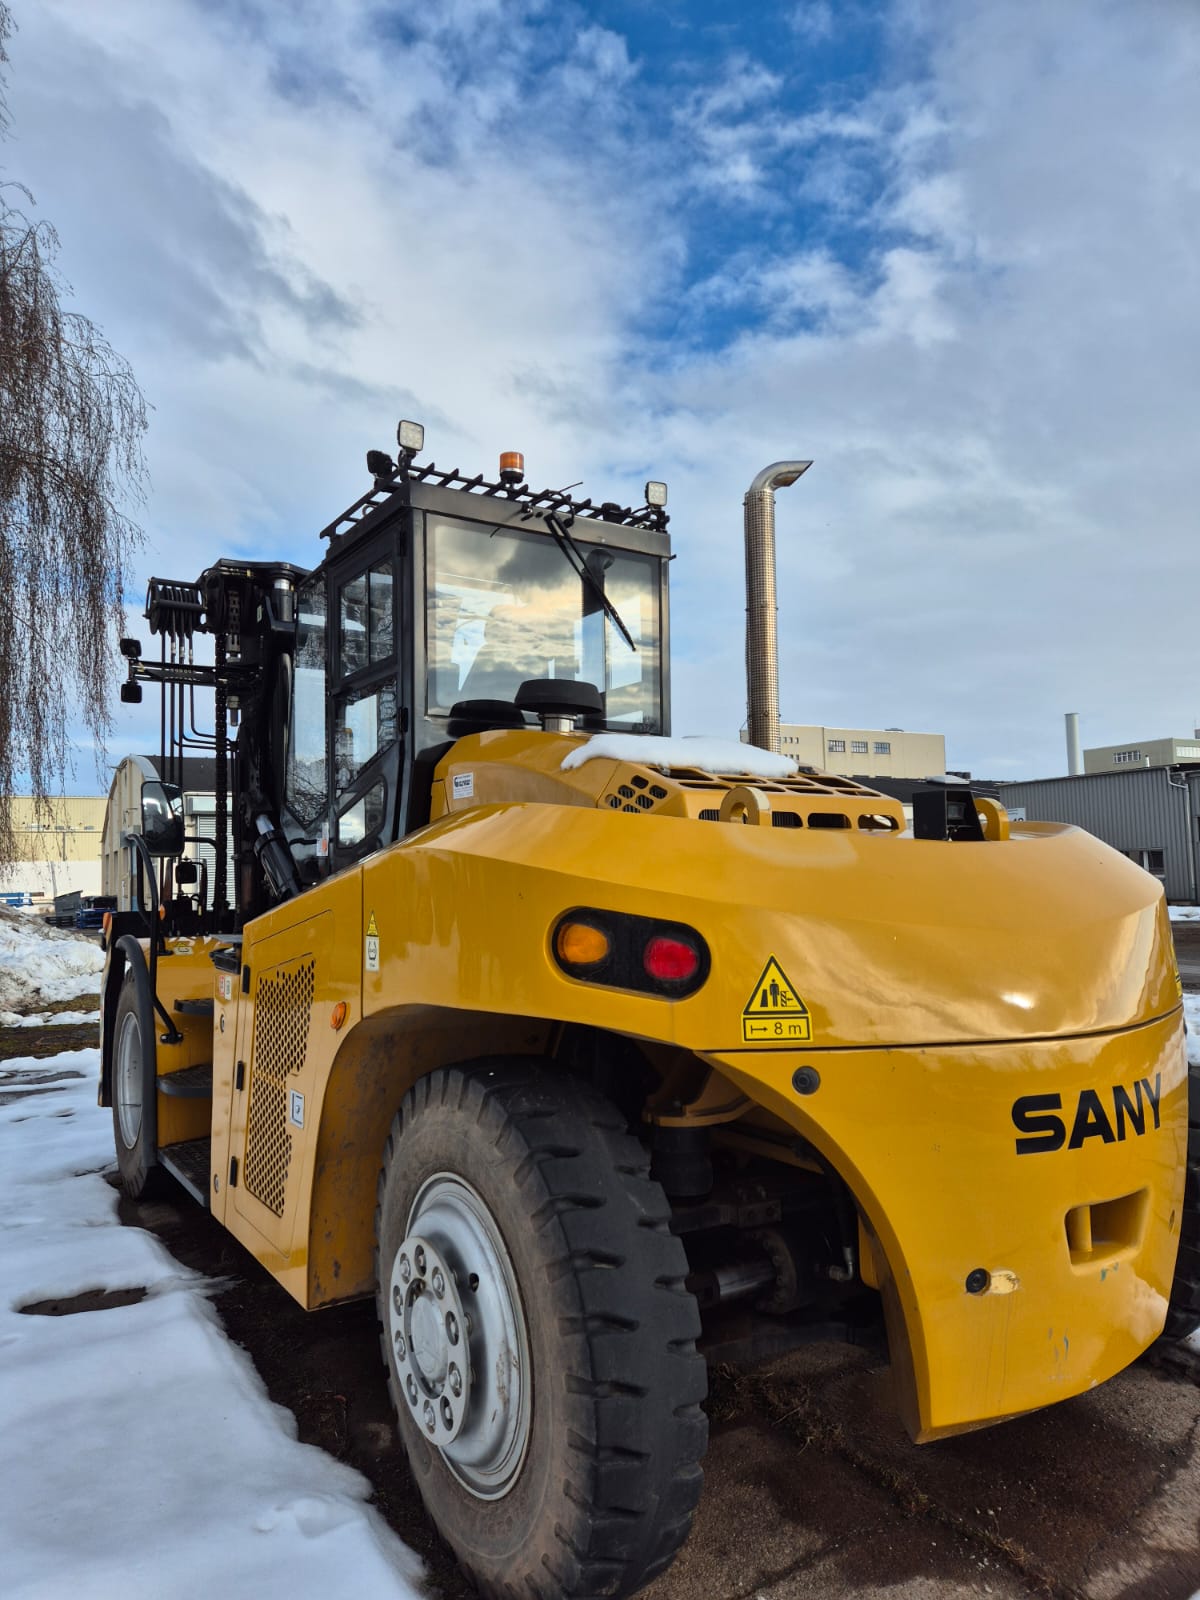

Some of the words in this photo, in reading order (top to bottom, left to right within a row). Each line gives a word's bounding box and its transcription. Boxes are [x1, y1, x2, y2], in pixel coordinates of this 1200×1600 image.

[774, 1021, 783, 1035] 8
[788, 1024, 802, 1035] m
[1011, 1071, 1161, 1155] SANY
